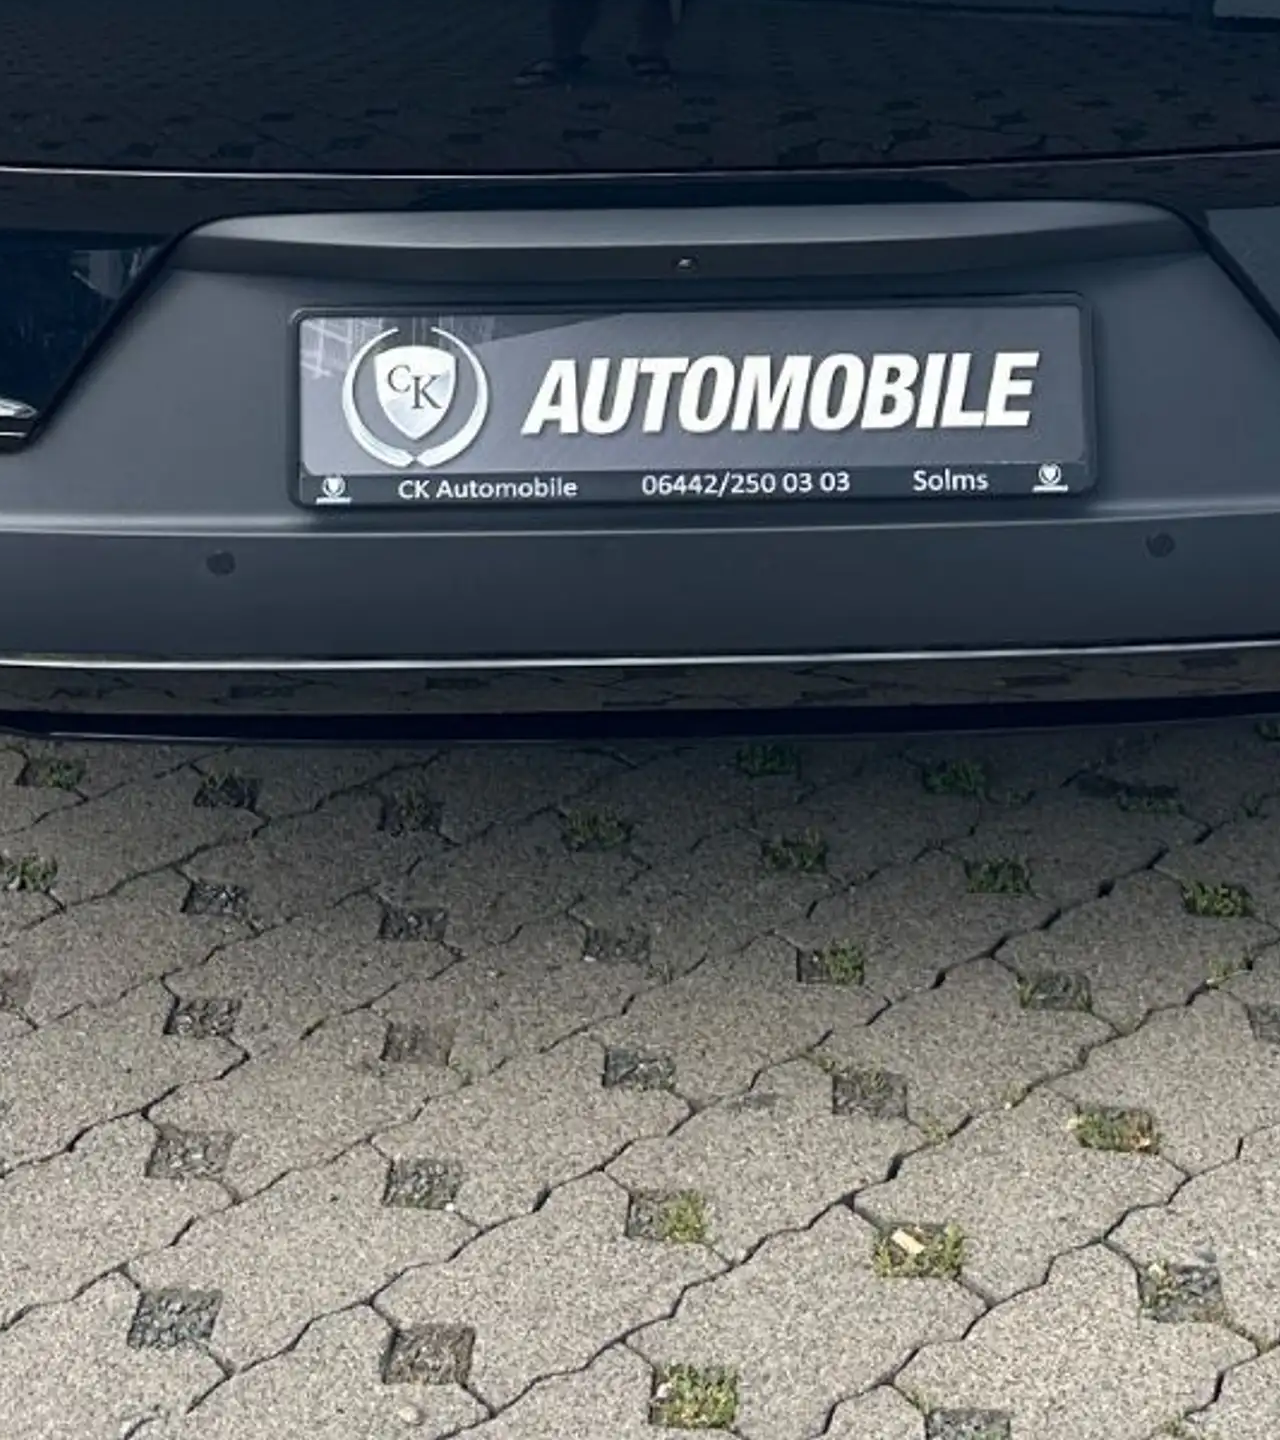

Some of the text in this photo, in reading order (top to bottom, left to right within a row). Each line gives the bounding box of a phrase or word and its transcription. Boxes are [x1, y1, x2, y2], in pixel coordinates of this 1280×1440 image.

[521, 351, 1040, 435] AUTOMOBILE
[398, 469, 989, 499] CK Automobile 06442/250 03 03 Solms
